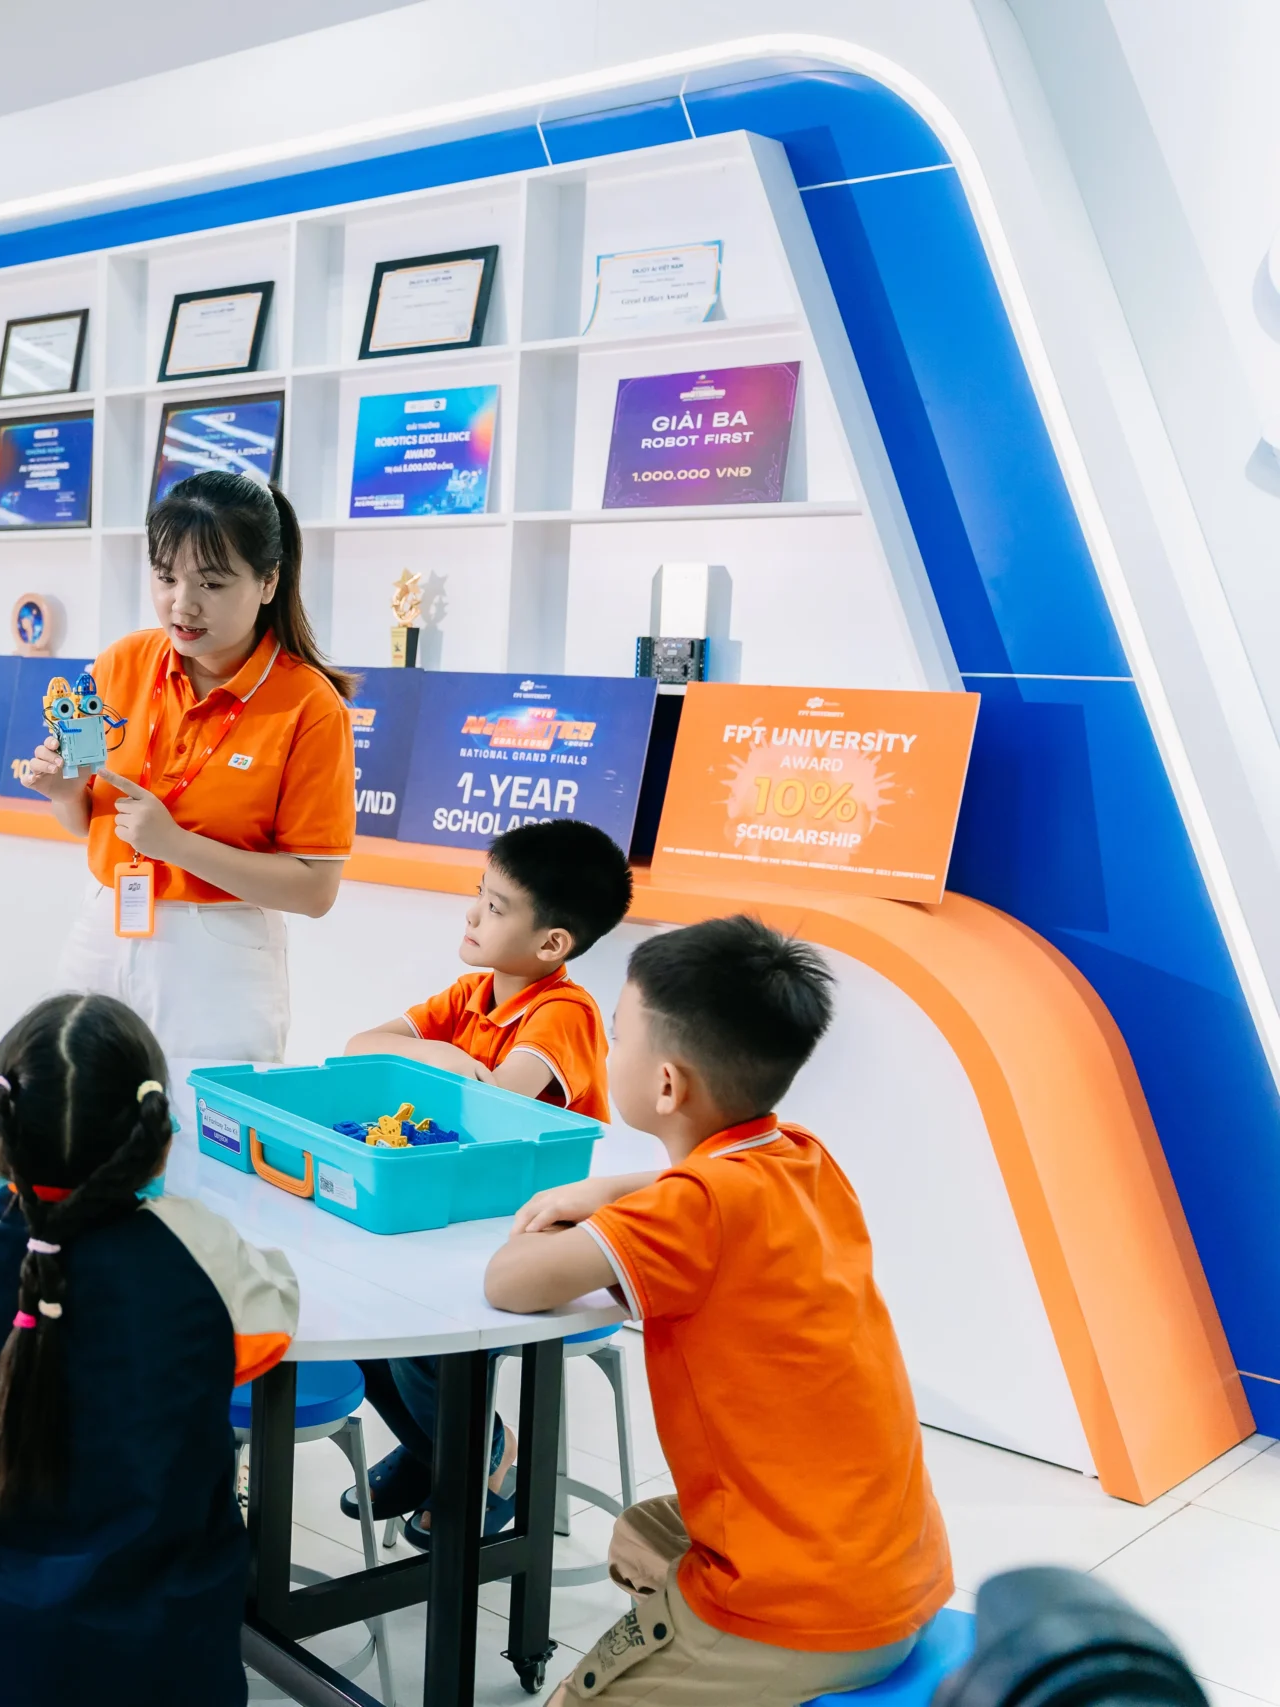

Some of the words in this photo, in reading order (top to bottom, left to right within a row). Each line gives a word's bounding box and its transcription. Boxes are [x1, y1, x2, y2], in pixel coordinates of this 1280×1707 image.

[666, 292, 689, 301] Award
[652, 411, 702, 432] GIẢI
[713, 411, 748, 428] BA
[375, 434, 417, 447] ROBOTICS
[418, 431, 471, 444] EXCELLENCE
[641, 435, 699, 449] ROBOT
[704, 431, 754, 446] FIRST
[404, 448, 436, 460] AWARD
[632, 468, 711, 482] 1.000.000
[716, 466, 752, 478] VNĐ
[723, 724, 766, 744] FPT
[771, 727, 918, 753] UNIVERSITY
[460, 748, 508, 760] NATIONAL
[512, 751, 547, 763] GRAND
[550, 754, 588, 766] FINALS
[780, 755, 844, 772] AWARD
[456, 771, 579, 814] 1-YEAR
[754, 776, 858, 822] 10%
[735, 823, 862, 848] SCHOLARSHIP
[208, 1116, 224, 1130] Fantasy
[224, 1123, 232, 1133] Zoo
